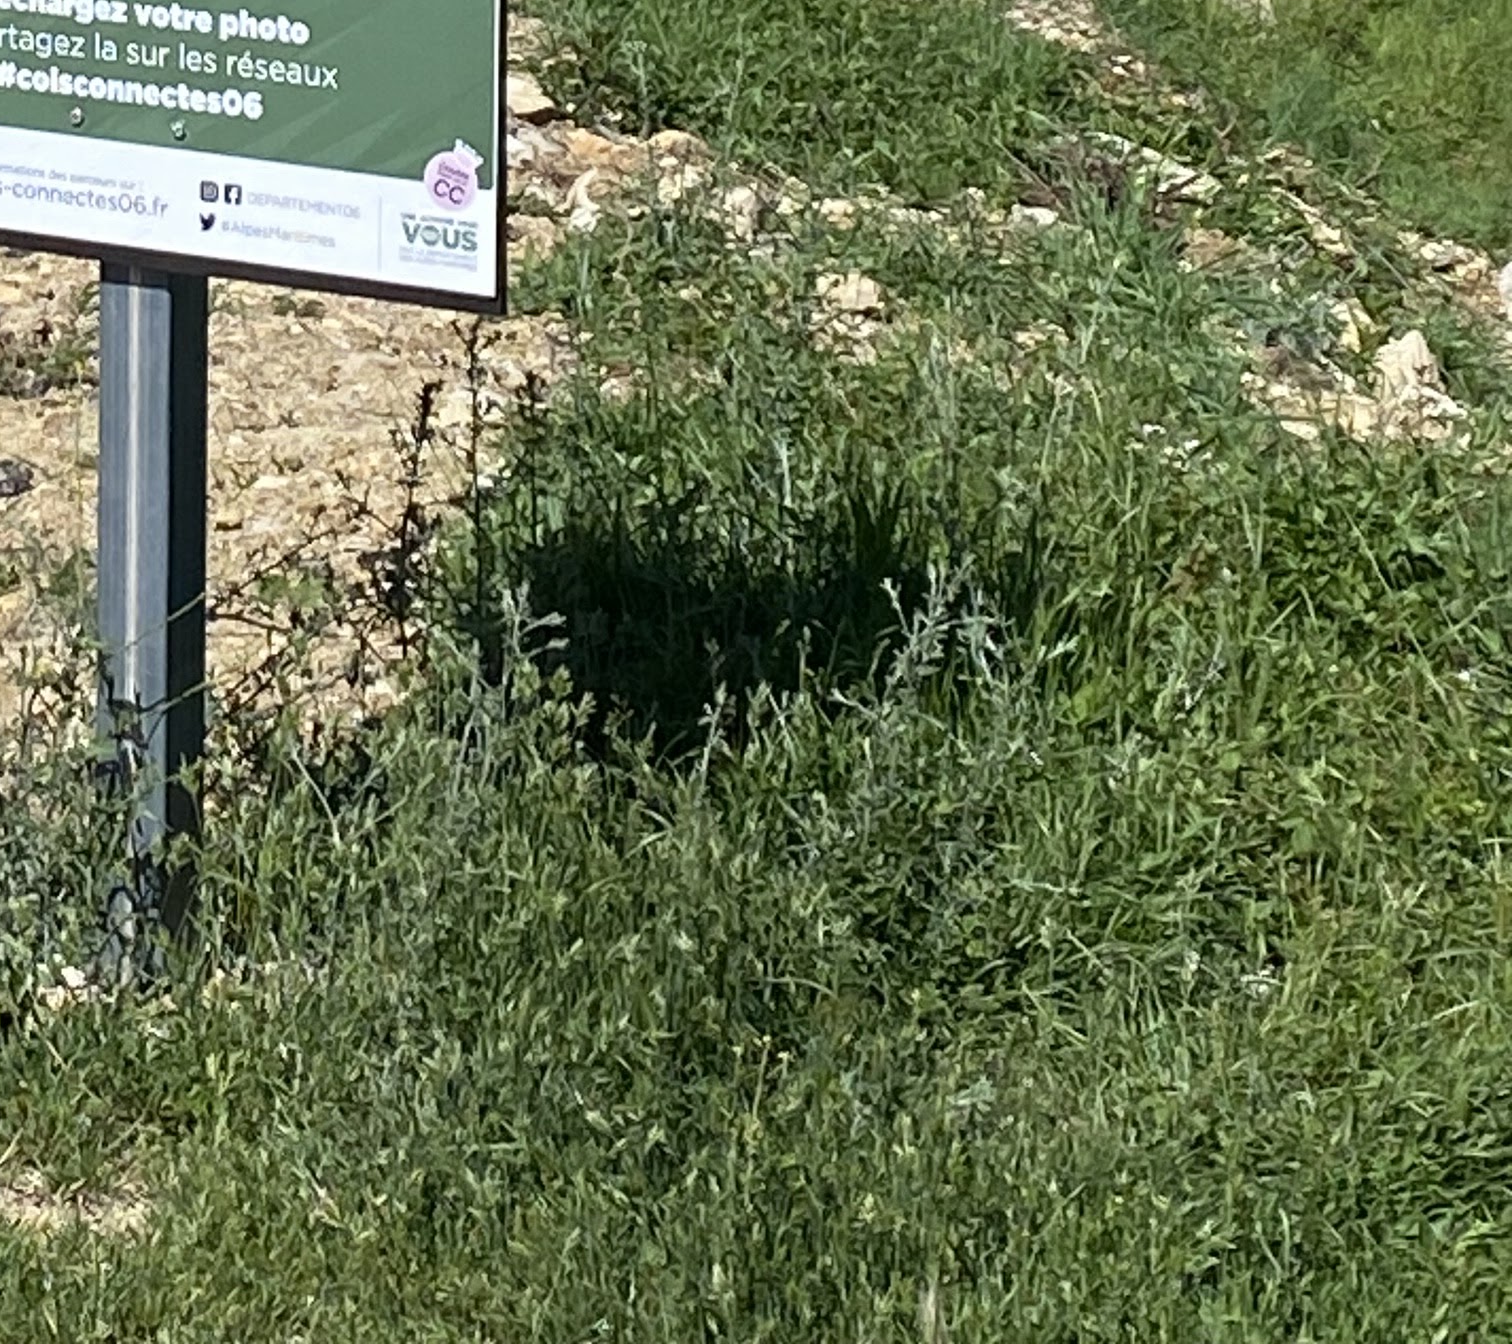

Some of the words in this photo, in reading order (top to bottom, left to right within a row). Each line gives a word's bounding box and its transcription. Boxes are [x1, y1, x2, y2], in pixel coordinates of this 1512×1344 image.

[132, 1, 214, 35] votre
[217, 7, 311, 46] photo
[93, 30, 118, 62] la
[125, 41, 172, 69] sur
[178, 41, 218, 75] les
[225, 49, 339, 91] réseaux
[433, 178, 466, 206] CC
[401, 220, 479, 253] VOUS
